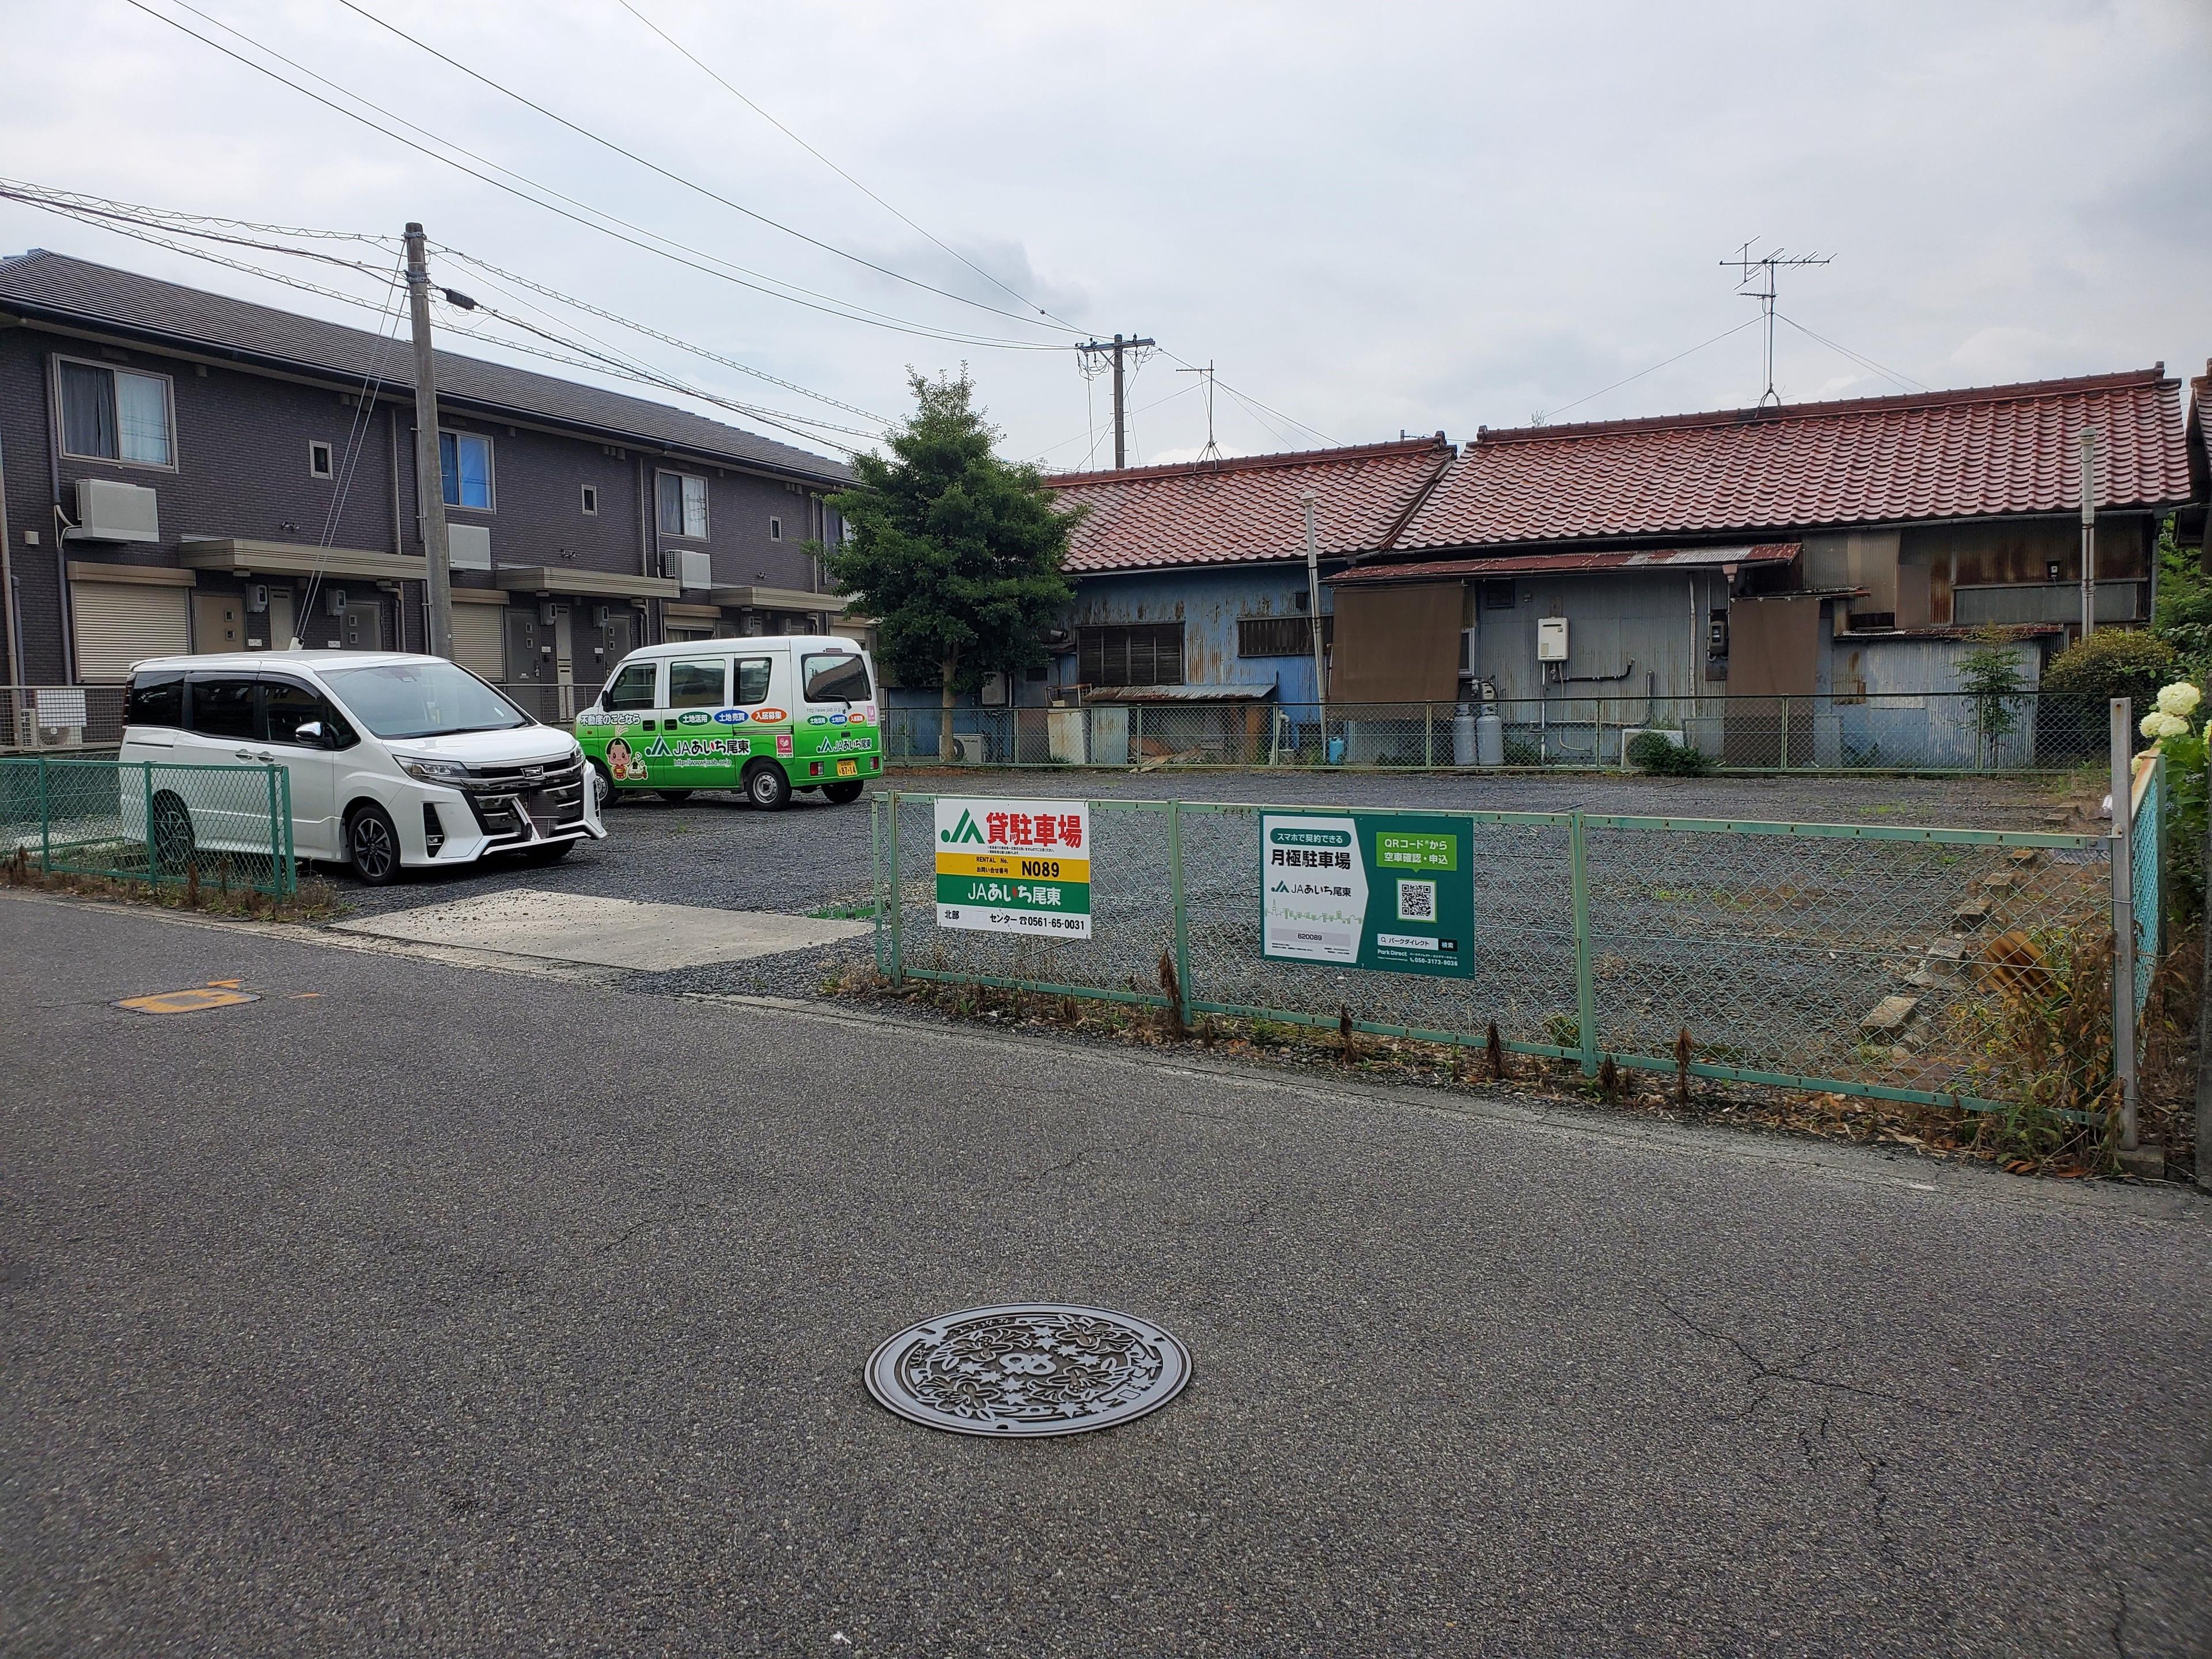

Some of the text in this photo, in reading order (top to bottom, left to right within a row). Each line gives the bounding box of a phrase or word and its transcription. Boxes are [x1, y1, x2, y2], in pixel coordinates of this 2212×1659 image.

[581, 714, 641, 726] 不動産のことなら
[683, 714, 707, 723] 土地活用
[719, 713, 745, 721] 土地売買
[674, 738, 750, 755] JAあいち尾東
[986, 812, 1082, 848] 貸駐車場
[1277, 833, 1343, 843] スマホで契約できる
[1271, 849, 1351, 870] 月極駐車場
[1384, 852, 1448, 864] 空車確認・申込
[976, 866, 1009, 874] お問い合せ番号
[1022, 861, 1060, 878] N089
[968, 882, 1061, 906] JAあいち尾東
[1291, 884, 1351, 897] JAあいち尾東
[945, 910, 1085, 930] 北部 センター 0561-65-0031
[1389, 937, 1430, 946] パークダイレクト
